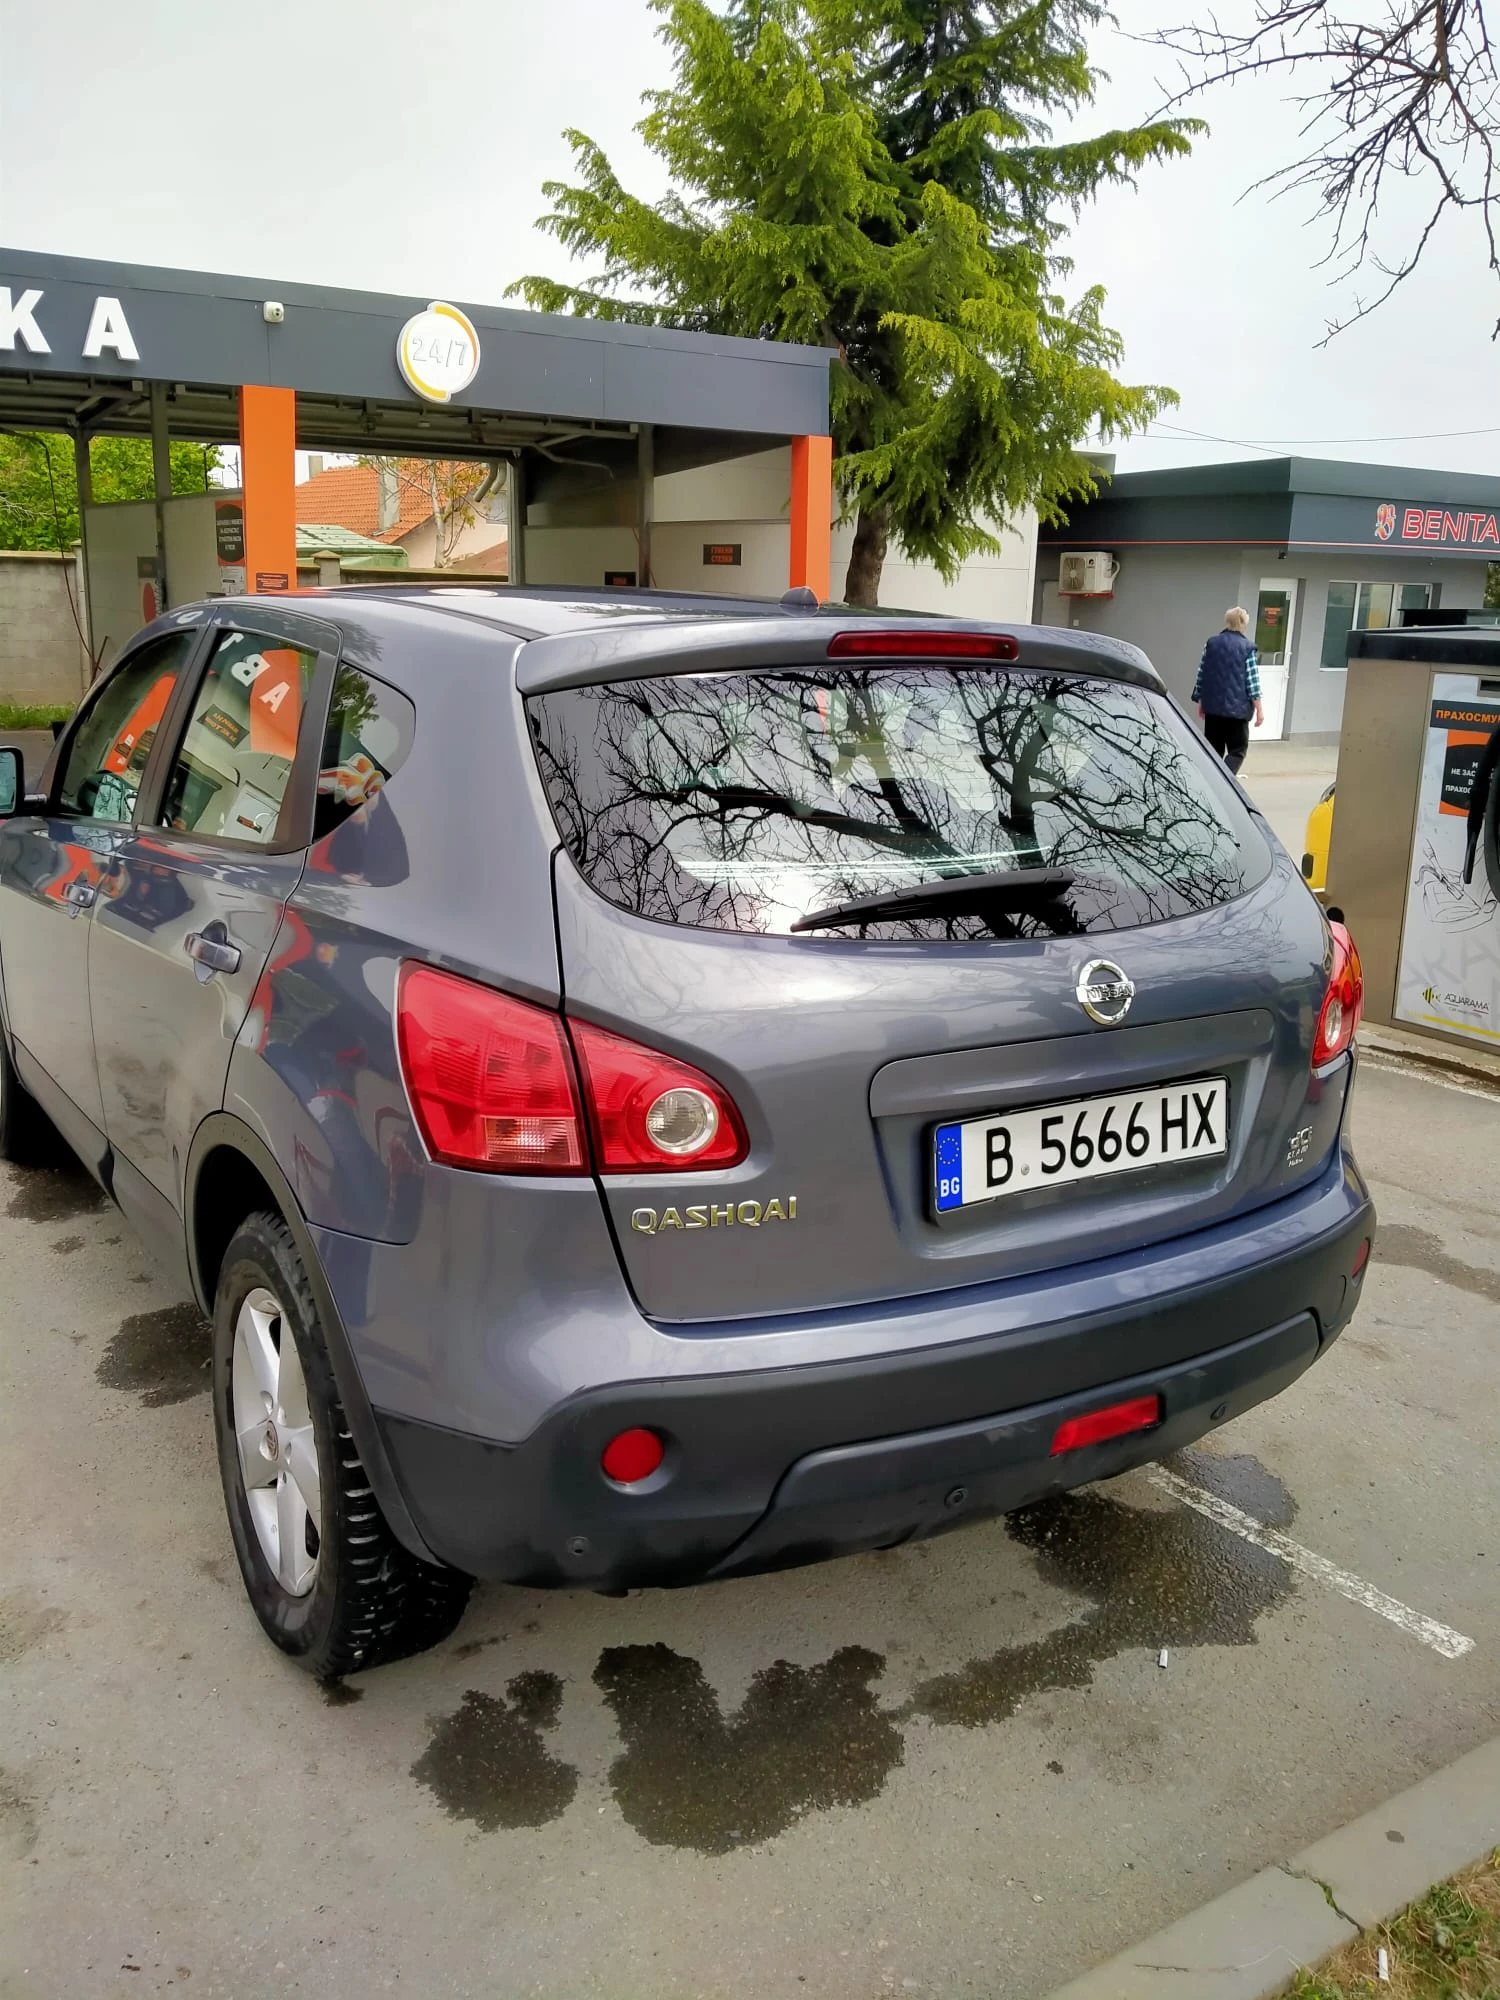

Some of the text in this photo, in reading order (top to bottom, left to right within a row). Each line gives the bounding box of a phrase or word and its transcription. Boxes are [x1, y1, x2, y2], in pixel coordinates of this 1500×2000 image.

[412, 337, 467, 368] 24/7
[1402, 508, 1500, 544] BENITA
[1450, 767, 1477, 777] НЕ ЗАС
[1087, 984, 1133, 1000] NISSAN
[1444, 992, 1490, 1010] AQUARAMA
[1041, 1101, 1150, 1175] 5666
[940, 1177, 960, 1198] BG
[631, 1196, 798, 1235] QASHQAI
